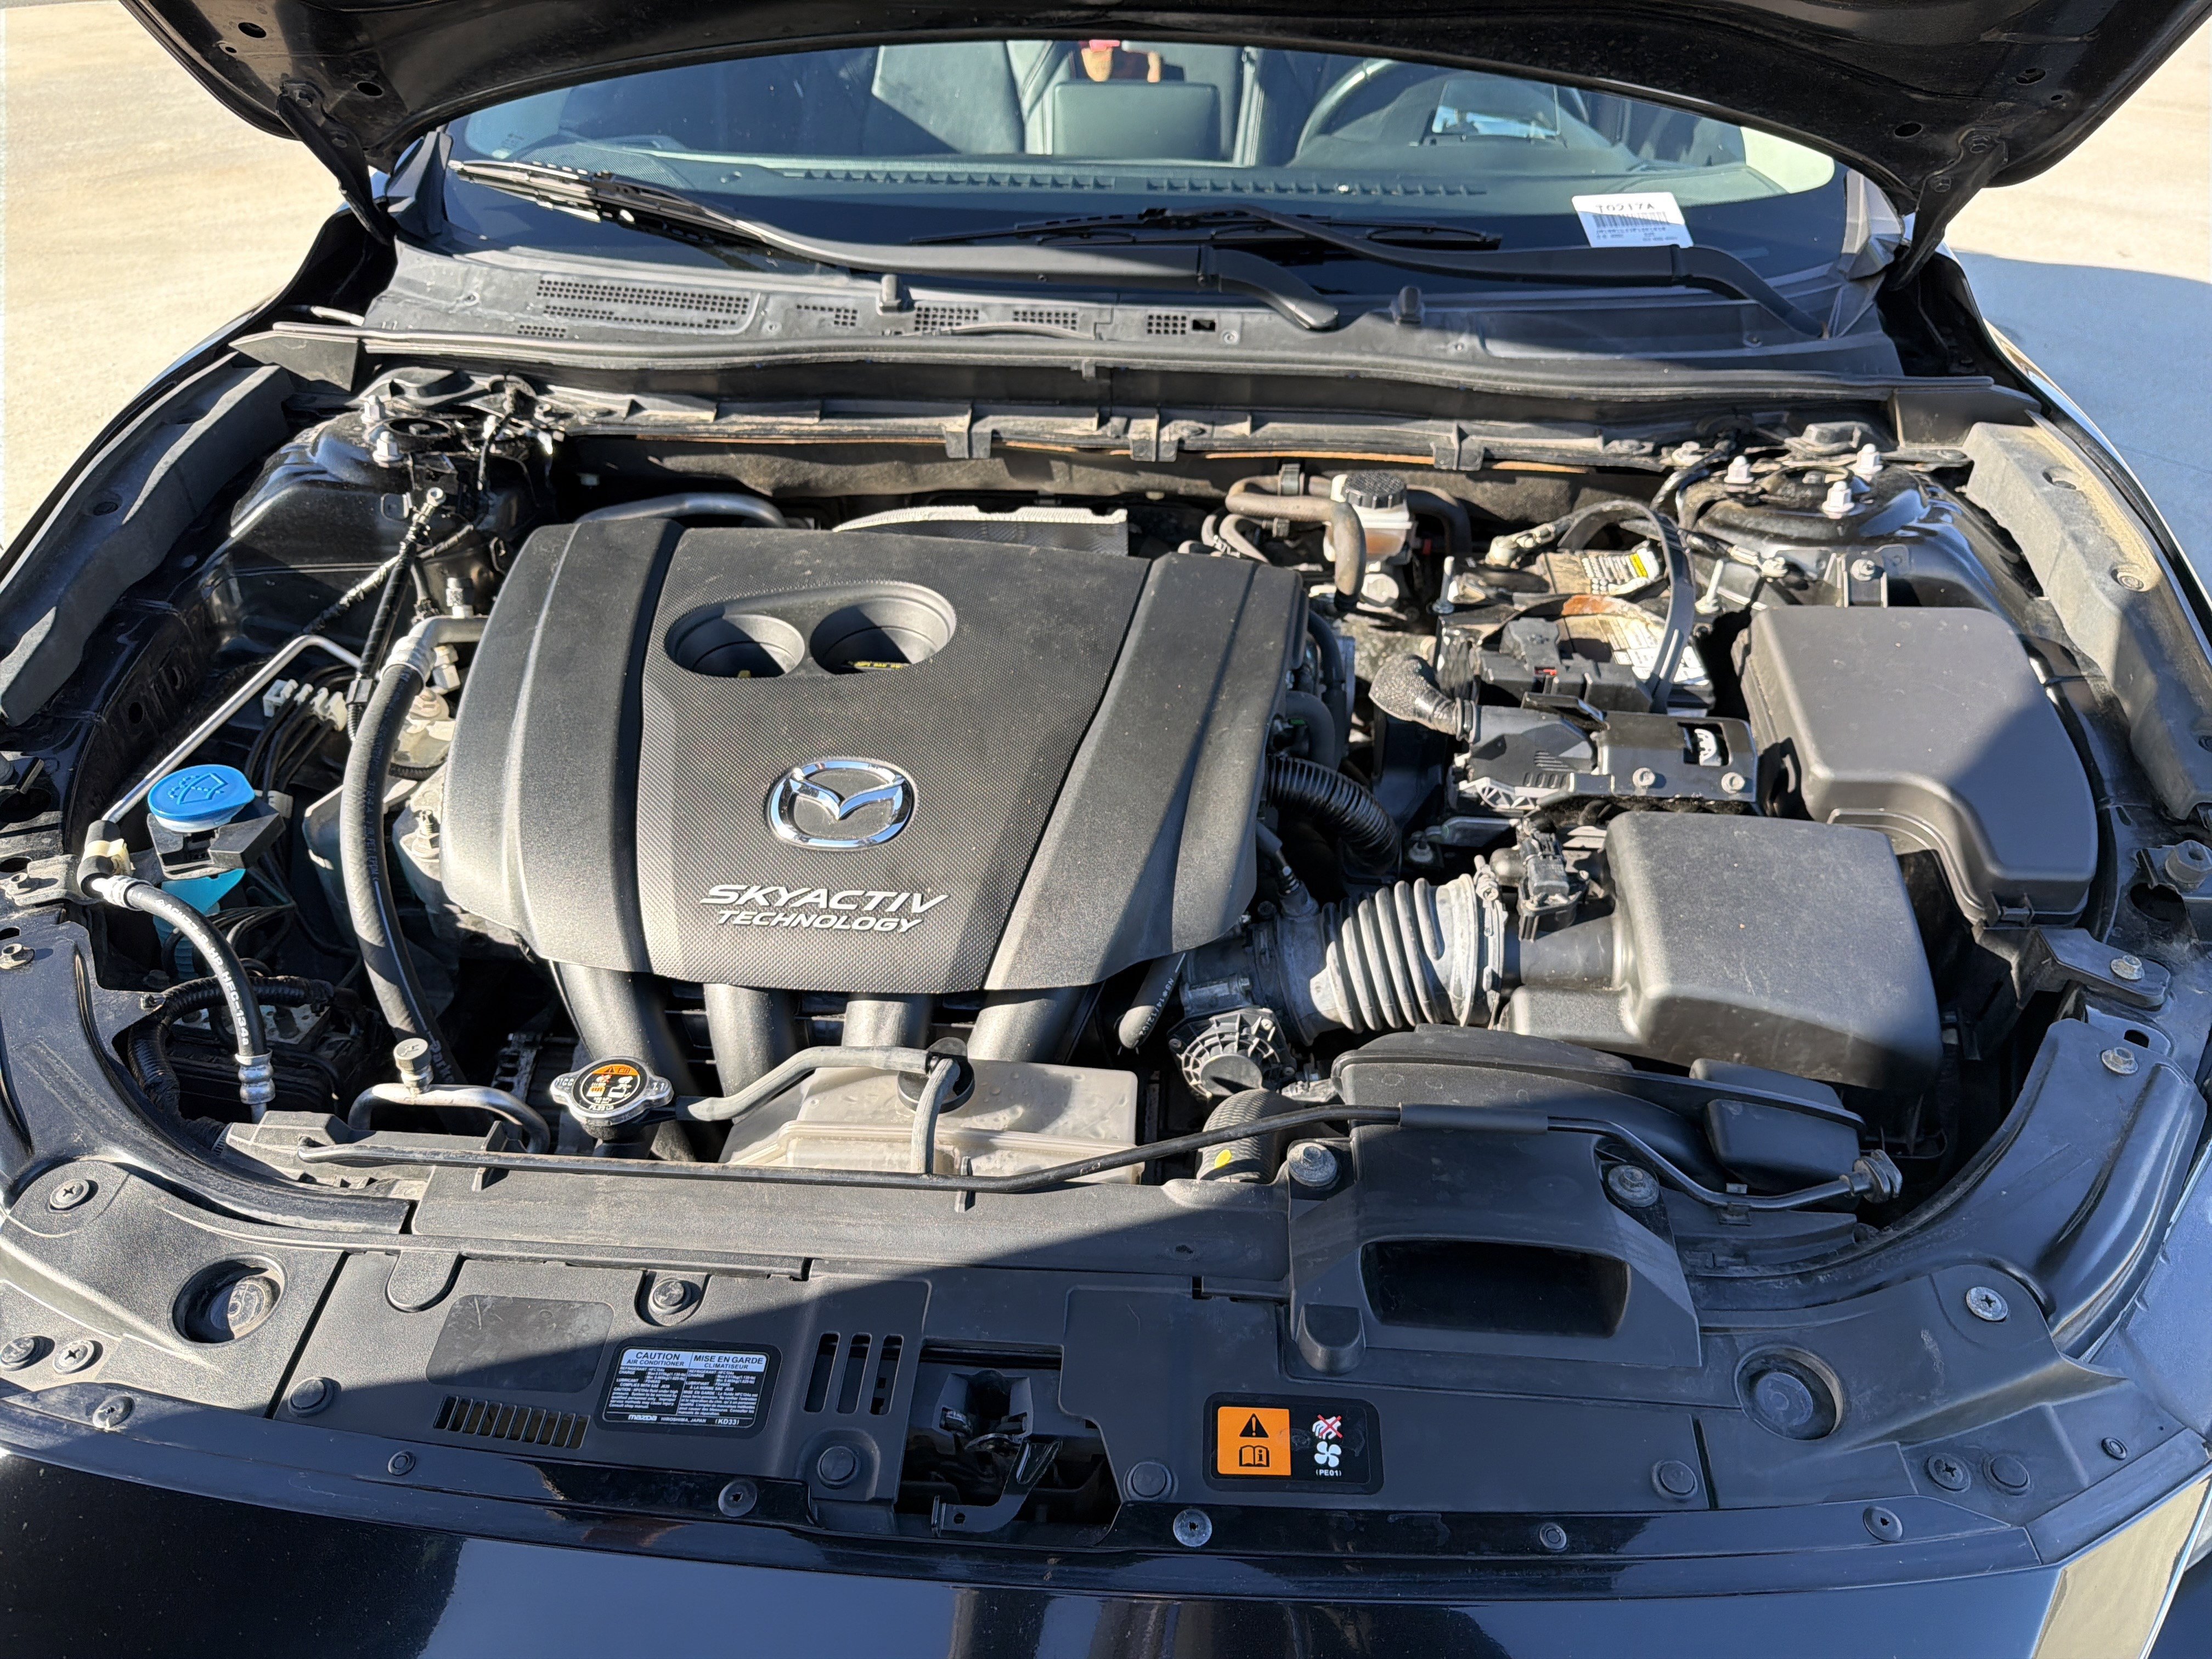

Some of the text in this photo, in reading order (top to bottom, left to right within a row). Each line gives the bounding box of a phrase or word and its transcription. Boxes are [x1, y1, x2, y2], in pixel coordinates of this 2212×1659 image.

[700, 884, 950, 913] SKYACTIV
[718, 910, 924, 933] TECHNOLOGY
[208, 947, 223, 966] HP
[221, 970, 249, 1046] HFC-134a
[635, 1351, 680, 1361] CAUTION
[1316, 1469, 1342, 1477] (PE01)
